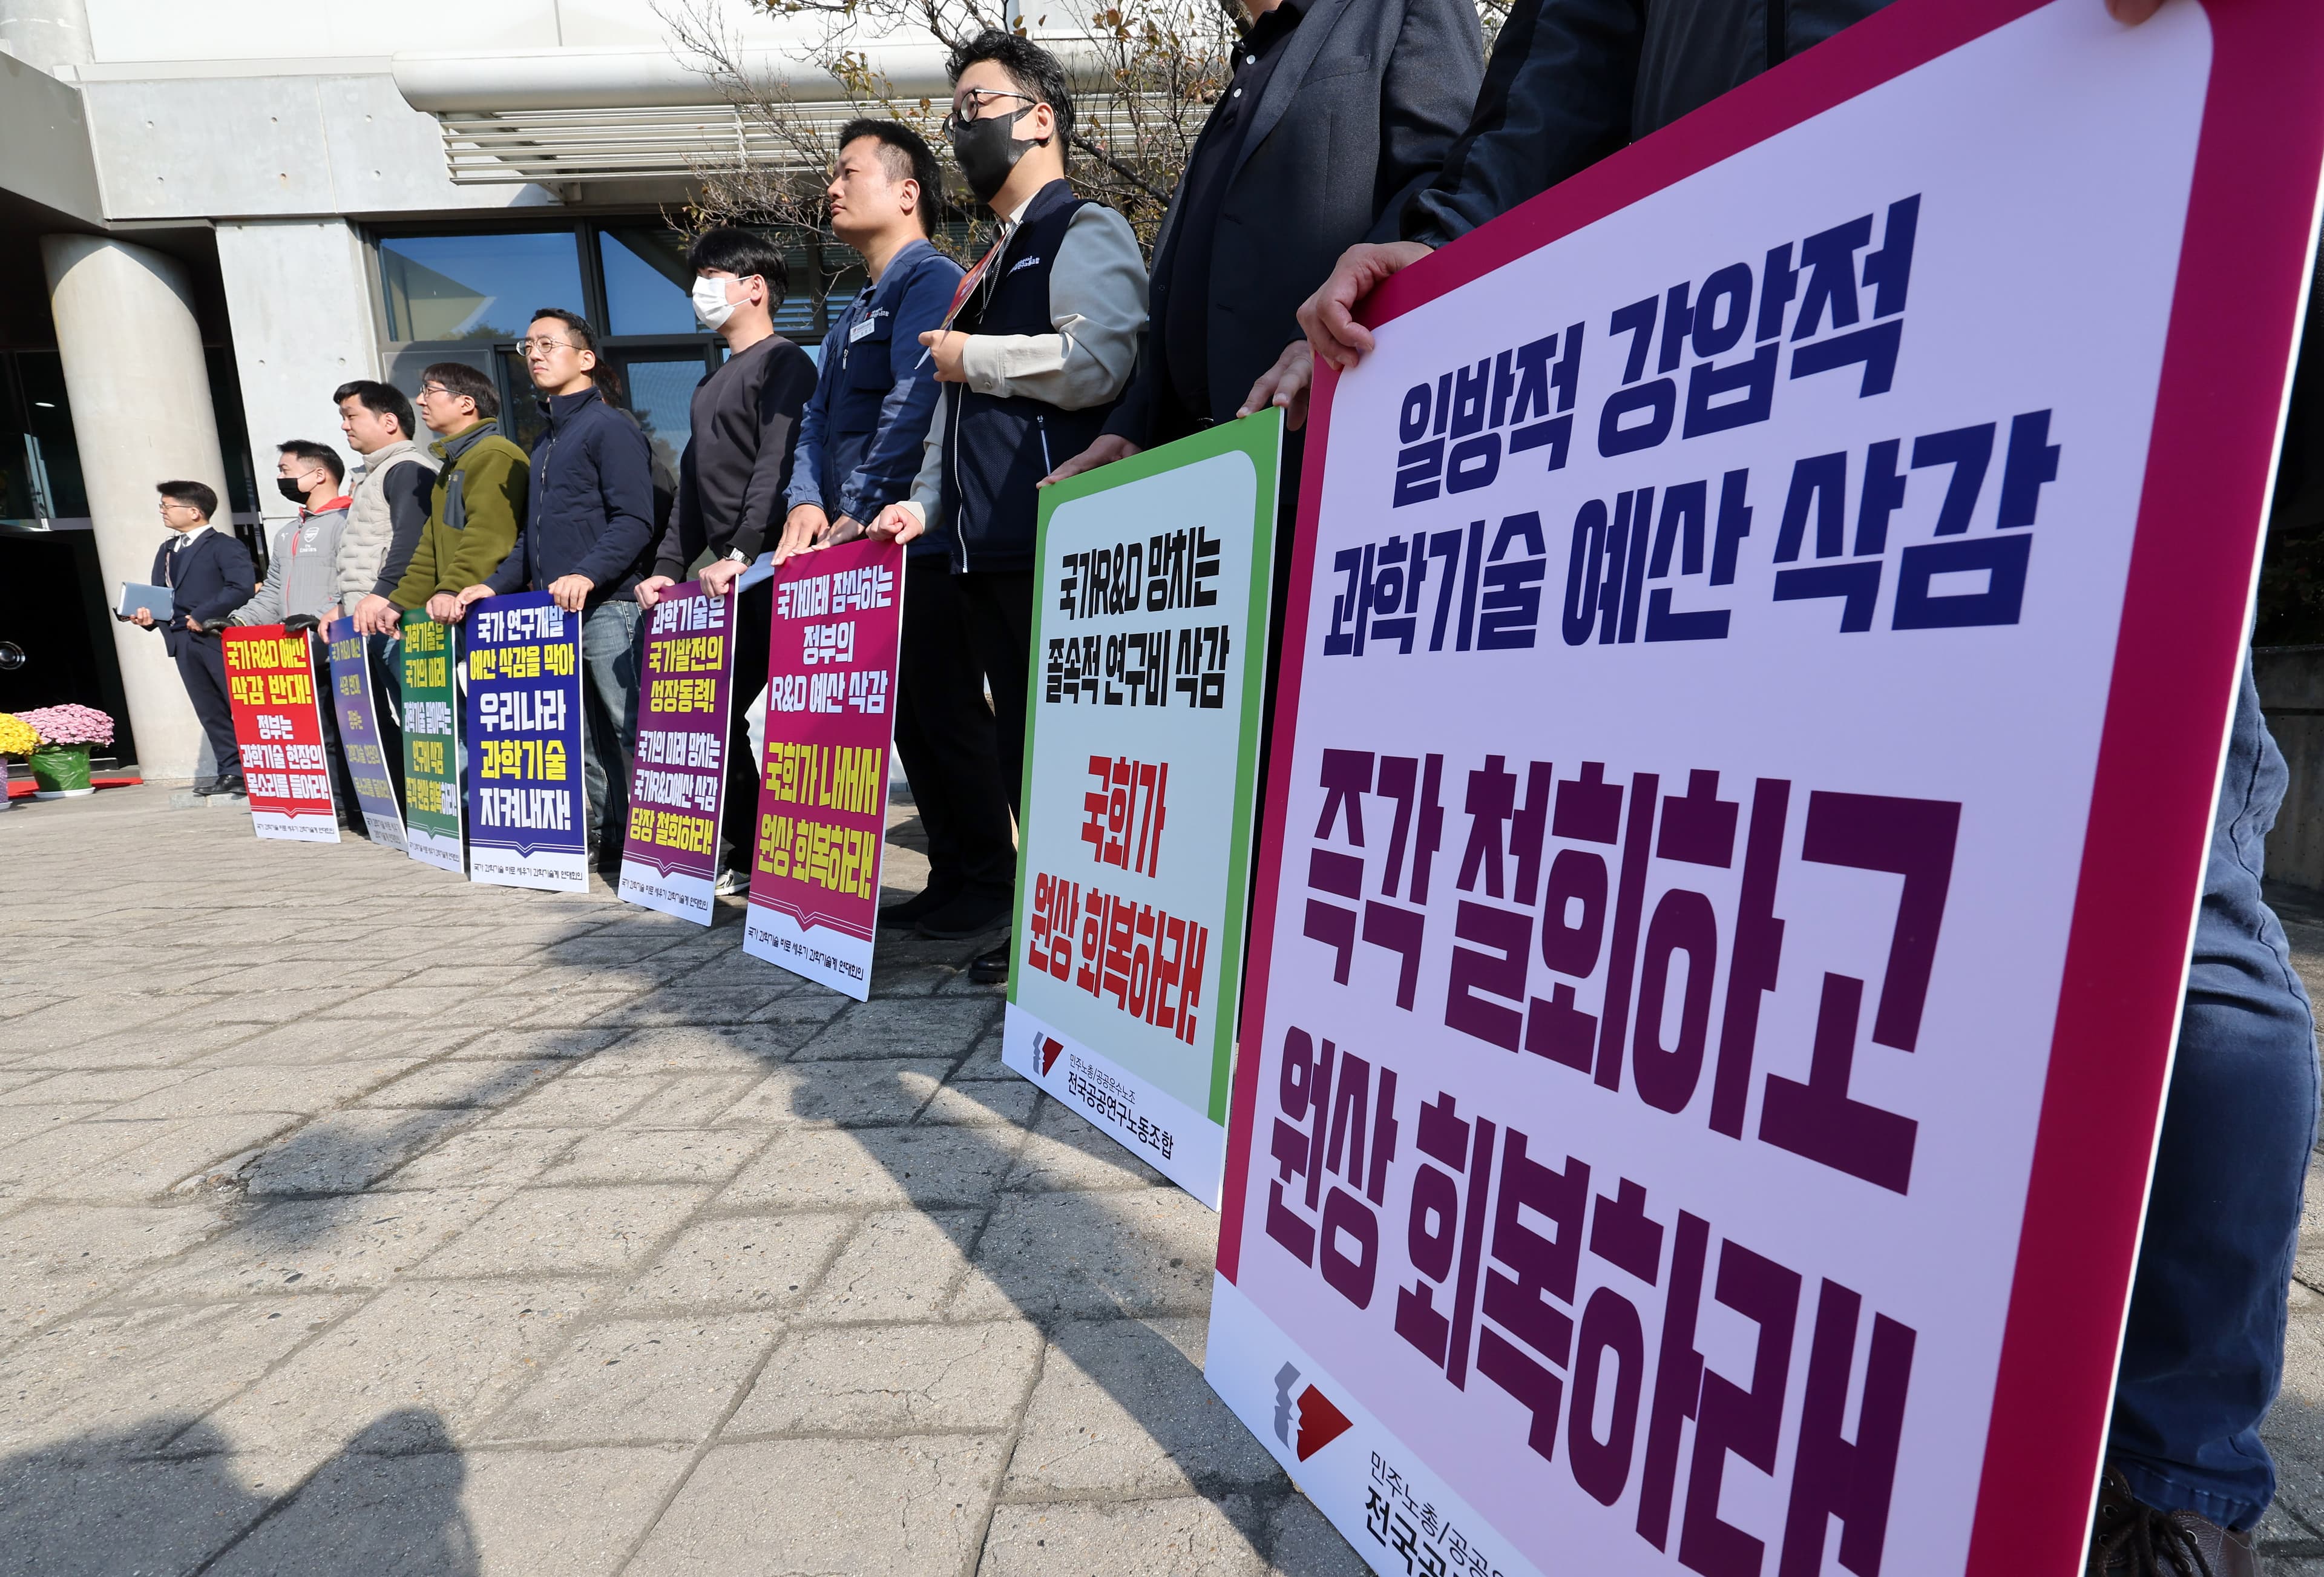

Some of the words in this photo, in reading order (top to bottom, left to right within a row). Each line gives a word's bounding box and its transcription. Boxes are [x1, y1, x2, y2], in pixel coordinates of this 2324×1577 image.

[1392, 321, 1586, 509] 일방적
[1597, 192, 1922, 459] 강압적
[1323, 510, 1548, 657] 과학기술
[1561, 467, 1754, 647] 예산
[1772, 408, 2063, 634] 삭감
[777, 575, 830, 620] 국가미래
[832, 564, 893, 614] 잠식하는
[1060, 542, 1143, 621] 국가R&D
[1146, 525, 1221, 613] 망치는
[478, 611, 504, 643] 국가
[507, 605, 564, 640] 연구개발
[651, 594, 725, 634] 과학기술은
[226, 640, 251, 670] 국가
[250, 639, 278, 668] R&D
[279, 637, 306, 668] 예산
[404, 621, 444, 653] 과학기술은
[649, 636, 723, 673] 국가발전의
[803, 621, 855, 665] 정부의
[428, 657, 445, 687] 미래
[470, 648, 496, 680] 예산
[499, 646, 540, 678] 삭감을
[544, 643, 575, 676] 막아
[1046, 634, 1101, 705] 졸속적
[1104, 629, 1172, 707] 연구비
[1175, 625, 1230, 709] 삭감
[231, 676, 265, 705] 삭감
[268, 674, 312, 705] 반대!
[480, 690, 566, 732] 우리나라
[651, 679, 715, 713] 성장동력!
[770, 674, 807, 713] R&D
[809, 672, 845, 713] 예산
[849, 670, 888, 714] 삭감
[257, 715, 294, 740] 정부는
[638, 730, 665, 763] 국가의
[665, 731, 687, 765] 미래
[688, 732, 720, 769] 망치는
[240, 744, 286, 769] 과학기술
[286, 745, 324, 769] 현장의
[481, 740, 566, 780] 과학기술
[766, 741, 818, 806] 국회가
[819, 745, 882, 816] 나서서
[246, 773, 290, 798] 목소리를
[289, 774, 329, 800] 들어라!
[694, 775, 718, 812] 삭감
[480, 788, 571, 831] 지켜내자!
[629, 807, 655, 842] 당장
[655, 811, 714, 855] 철회하라!
[1081, 755, 1169, 878] 국회가
[758, 814, 794, 878] 원상
[792, 818, 876, 901] 회복하라!
[748, 926, 758, 940] 국가
[759, 930, 779, 948] 과학기술
[780, 938, 792, 952] 바로
[792, 943, 808, 960] 세우기
[809, 949, 838, 971] 과학기술계
[839, 960, 864, 981] 연대회의
[1028, 872, 1080, 983] 원상
[1076, 887, 1209, 1046] 회복하라!
[1302, 748, 1445, 1014] 즉각
[1443, 752, 1963, 1197] 철회하고
[1068, 1071, 1174, 1161] 전국공공연구노동조합
[1264, 1024, 1399, 1312] 원상
[1365, 1485, 1462, 1577] 전국공
[1371, 1450, 1505, 1577] 민주노총/공공
